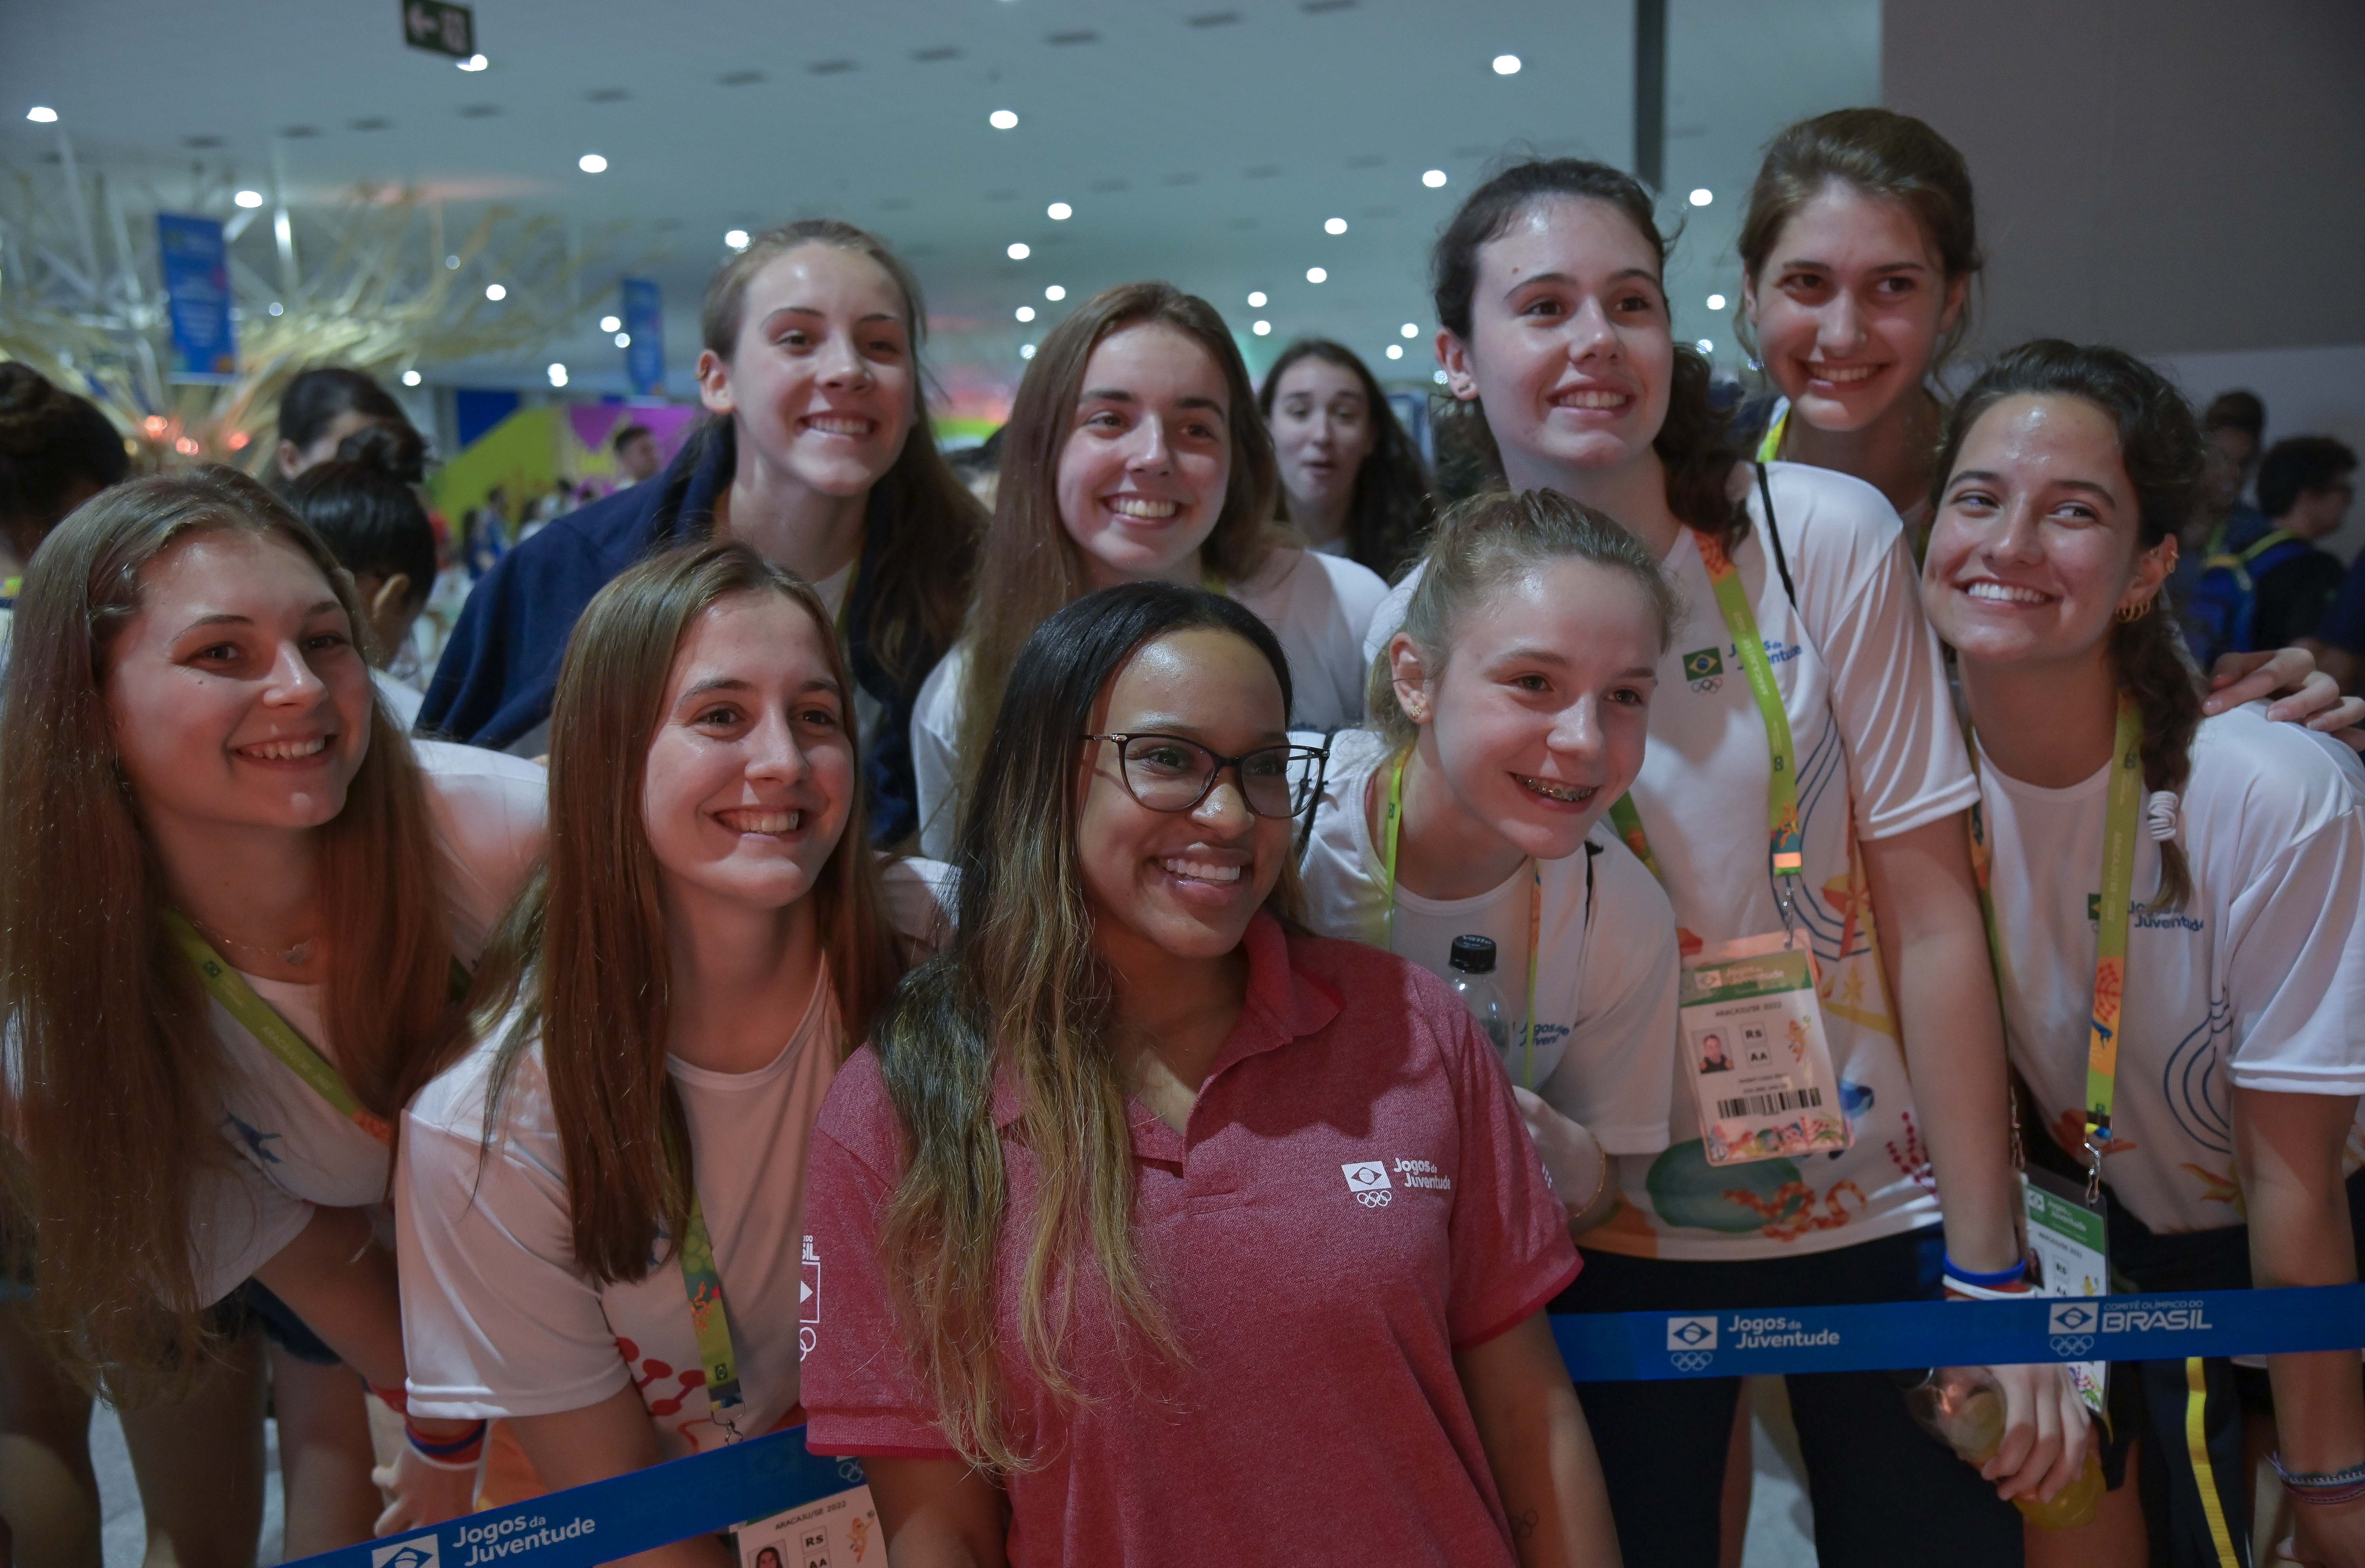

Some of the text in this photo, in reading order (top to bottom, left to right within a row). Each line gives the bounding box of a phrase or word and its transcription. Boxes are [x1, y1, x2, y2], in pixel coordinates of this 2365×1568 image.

[1746, 1030, 1762, 1038] RS
[1751, 1052, 1767, 1061] AA
[1394, 1157, 1431, 1176] Jogos
[1404, 1172, 1451, 1190] Juventude
[2189, 1299, 2204, 1308] DO
[1728, 1315, 1786, 1335] Jogos
[2102, 1309, 2213, 1333] BRASIL
[1735, 1328, 1841, 1349] Juventude
[827, 1500, 847, 1512] 2022
[452, 1515, 546, 1548] Jogos da
[464, 1517, 596, 1567] Juventude
[805, 1534, 824, 1548] RS
[810, 1557, 827, 1568] AA
